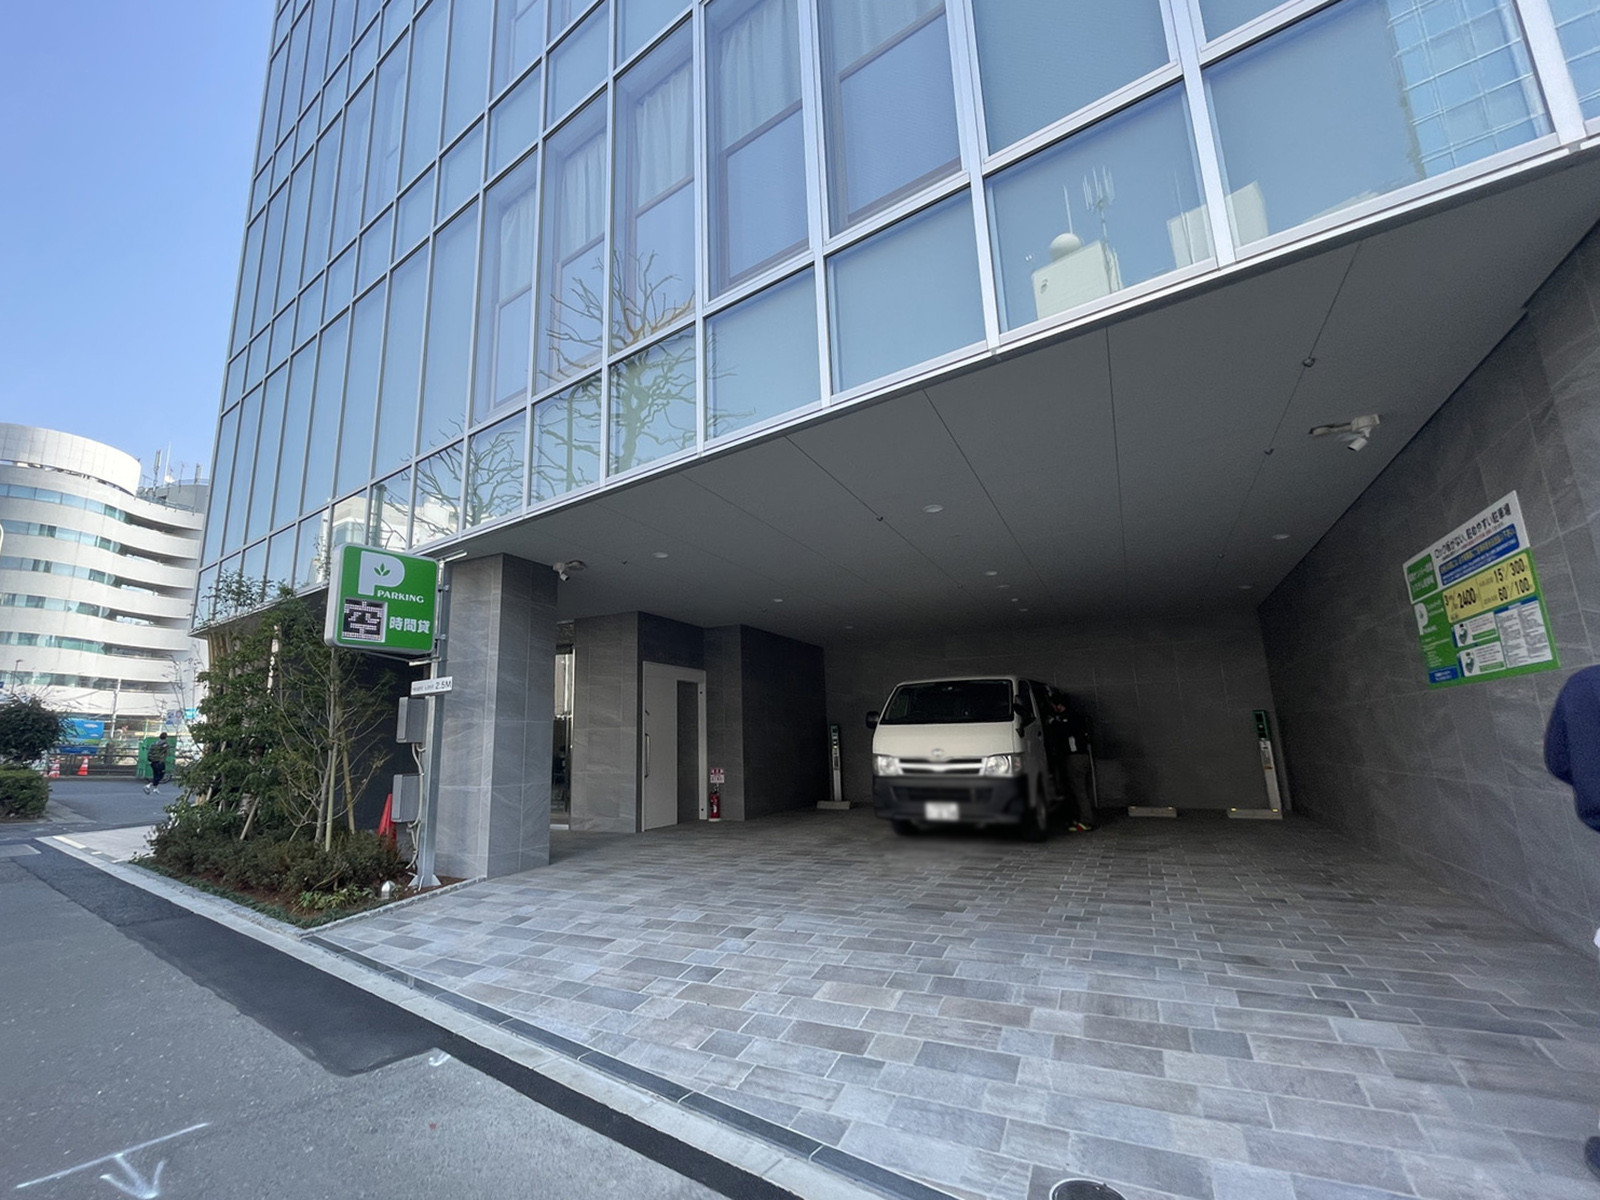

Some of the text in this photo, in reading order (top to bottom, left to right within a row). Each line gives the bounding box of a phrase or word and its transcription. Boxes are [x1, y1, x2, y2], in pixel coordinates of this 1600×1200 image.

[358, 551, 405, 596] P
[377, 590, 424, 603] PARKING
[342, 601, 382, 640] 空
[389, 616, 430, 634] 時間貸
